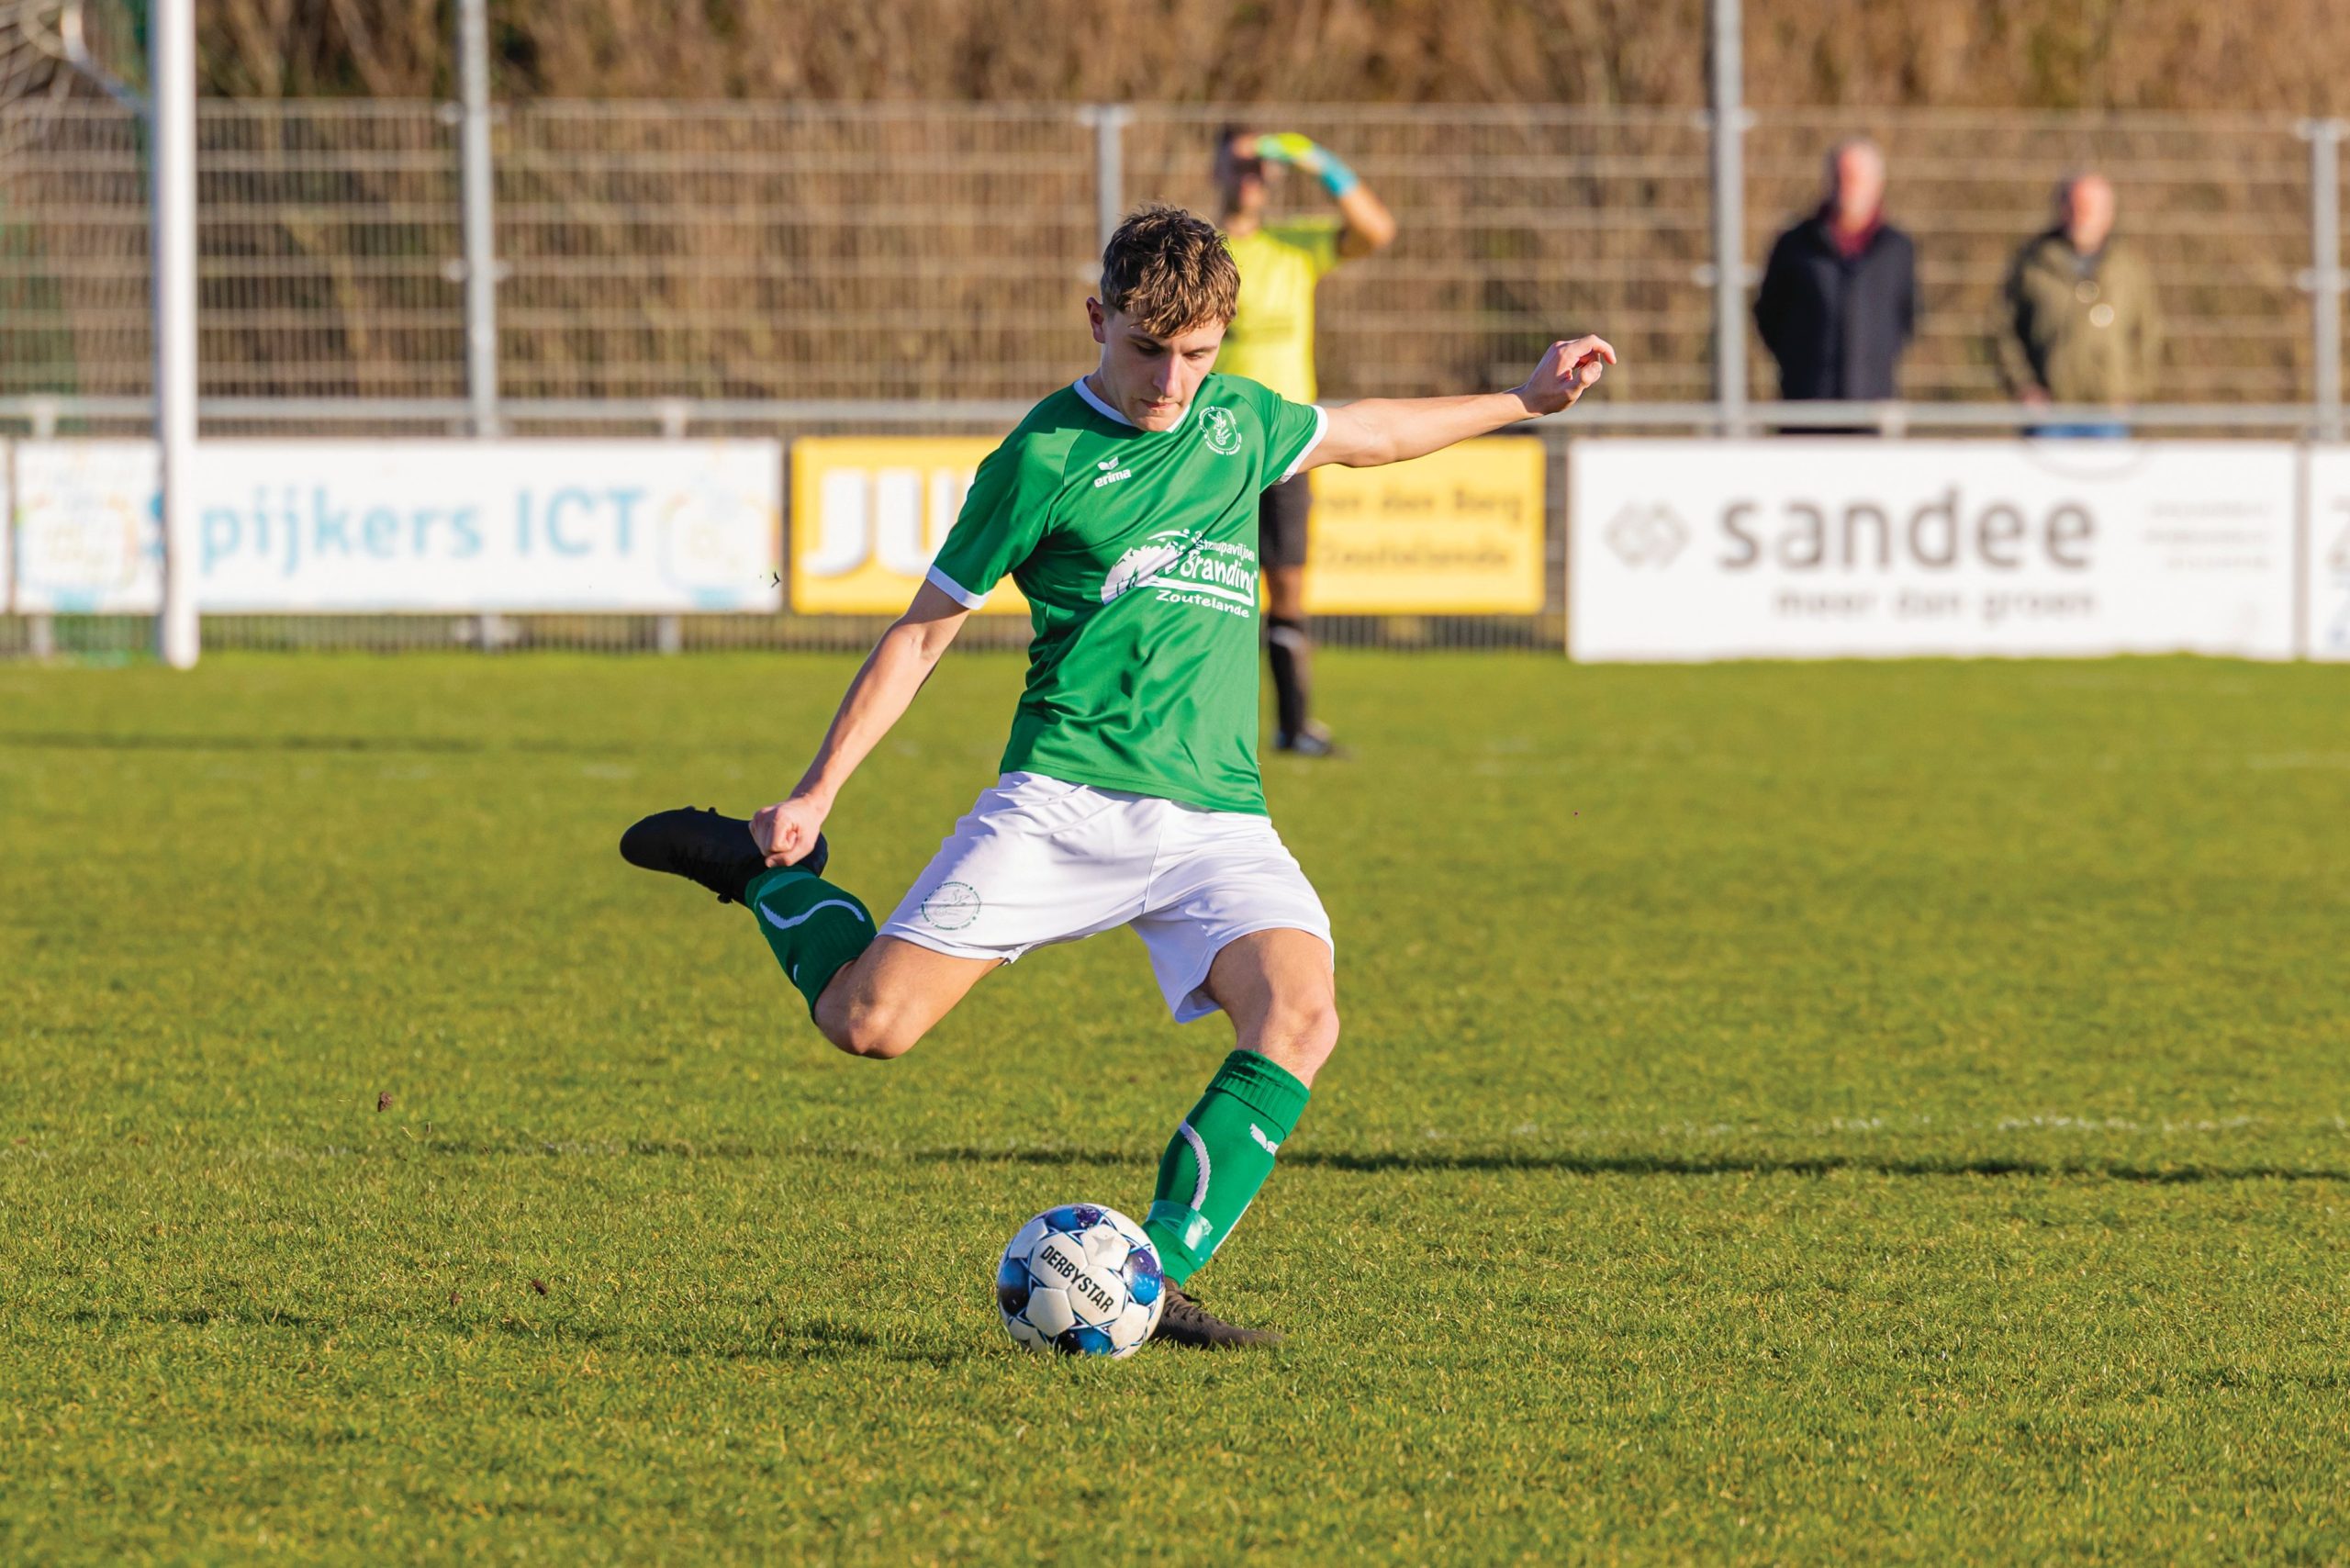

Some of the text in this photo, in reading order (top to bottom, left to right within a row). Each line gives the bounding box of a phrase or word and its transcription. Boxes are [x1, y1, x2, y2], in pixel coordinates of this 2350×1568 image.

[1094, 469, 1131, 488] erima
[147, 486, 646, 576] pijkers ICT
[797, 464, 973, 578] JU
[1718, 484, 2098, 574] sandee
[1155, 589, 1250, 619] Zoutelande
[1039, 1244, 1114, 1314] DERBYSTAR
